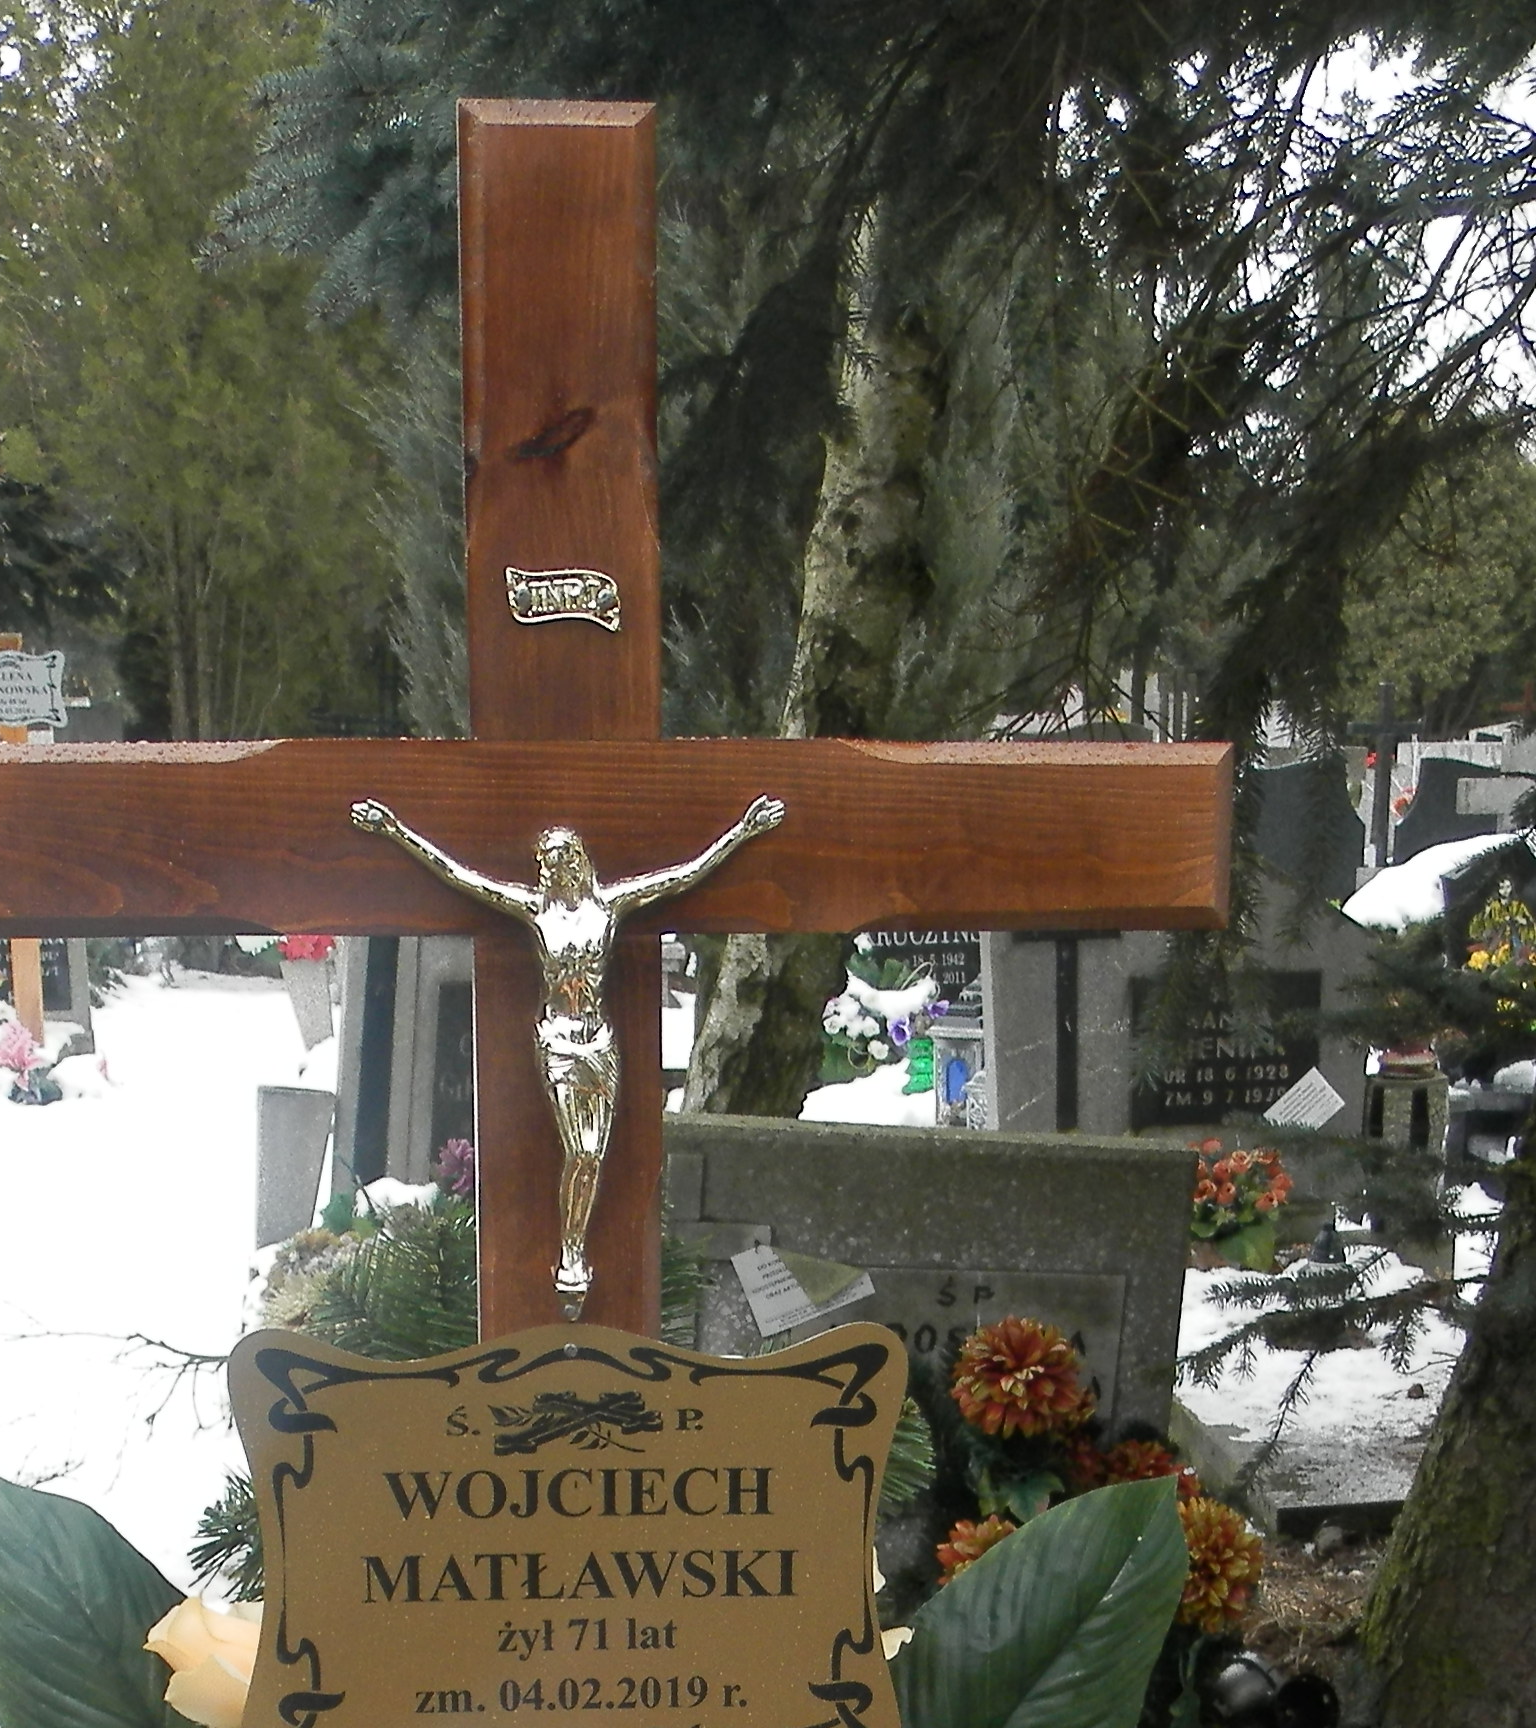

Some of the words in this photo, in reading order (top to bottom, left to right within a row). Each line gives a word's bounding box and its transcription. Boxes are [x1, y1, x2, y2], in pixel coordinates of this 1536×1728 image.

[446, 1406, 481, 1436] Ś.
[675, 1408, 705, 1431] P.
[382, 1467, 774, 1520] WOJCIECH
[361, 1549, 799, 1604] MATŁAWSKI
[497, 1617, 556, 1661] żył
[566, 1617, 610, 1651] 71
[626, 1617, 678, 1651] lat
[414, 1685, 486, 1715] zm.
[499, 1675, 709, 1714] 04.02.2019
[721, 1681, 748, 1710] r.
